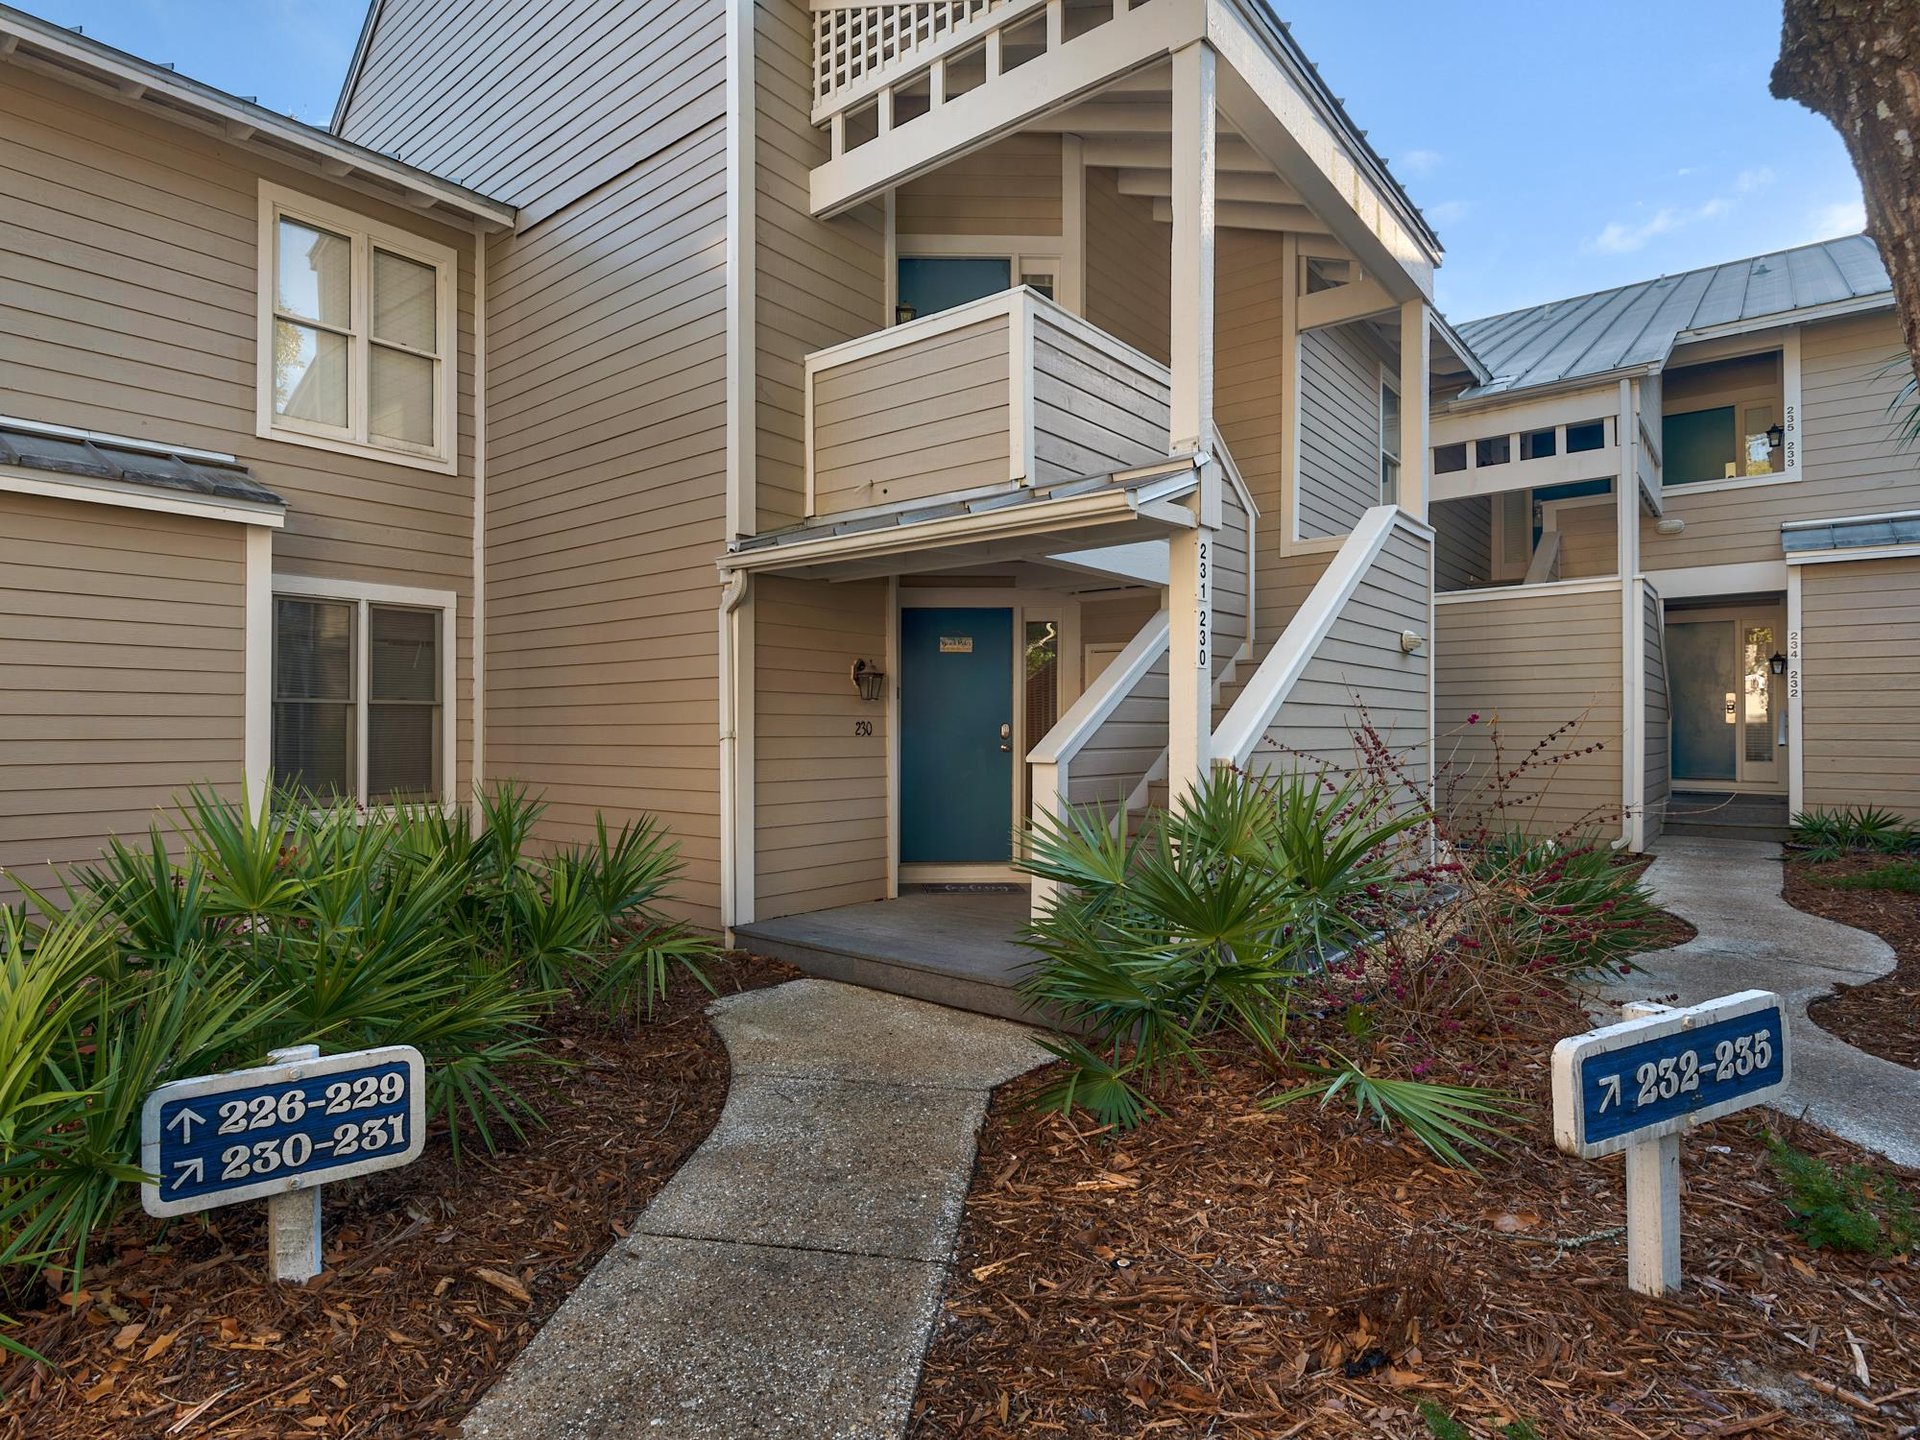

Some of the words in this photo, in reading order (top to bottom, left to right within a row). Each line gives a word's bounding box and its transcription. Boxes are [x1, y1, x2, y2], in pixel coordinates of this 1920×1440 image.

[1787, 406, 1795, 432] 235
[1787, 442, 1795, 467] 233
[1790, 632, 1798, 658] 234
[1790, 671, 1798, 697] 232
[855, 720, 873, 737] 230
[1636, 1028, 1772, 1107] 232-235
[217, 1072, 405, 1136] 226-229
[221, 1112, 405, 1181] 230-231
